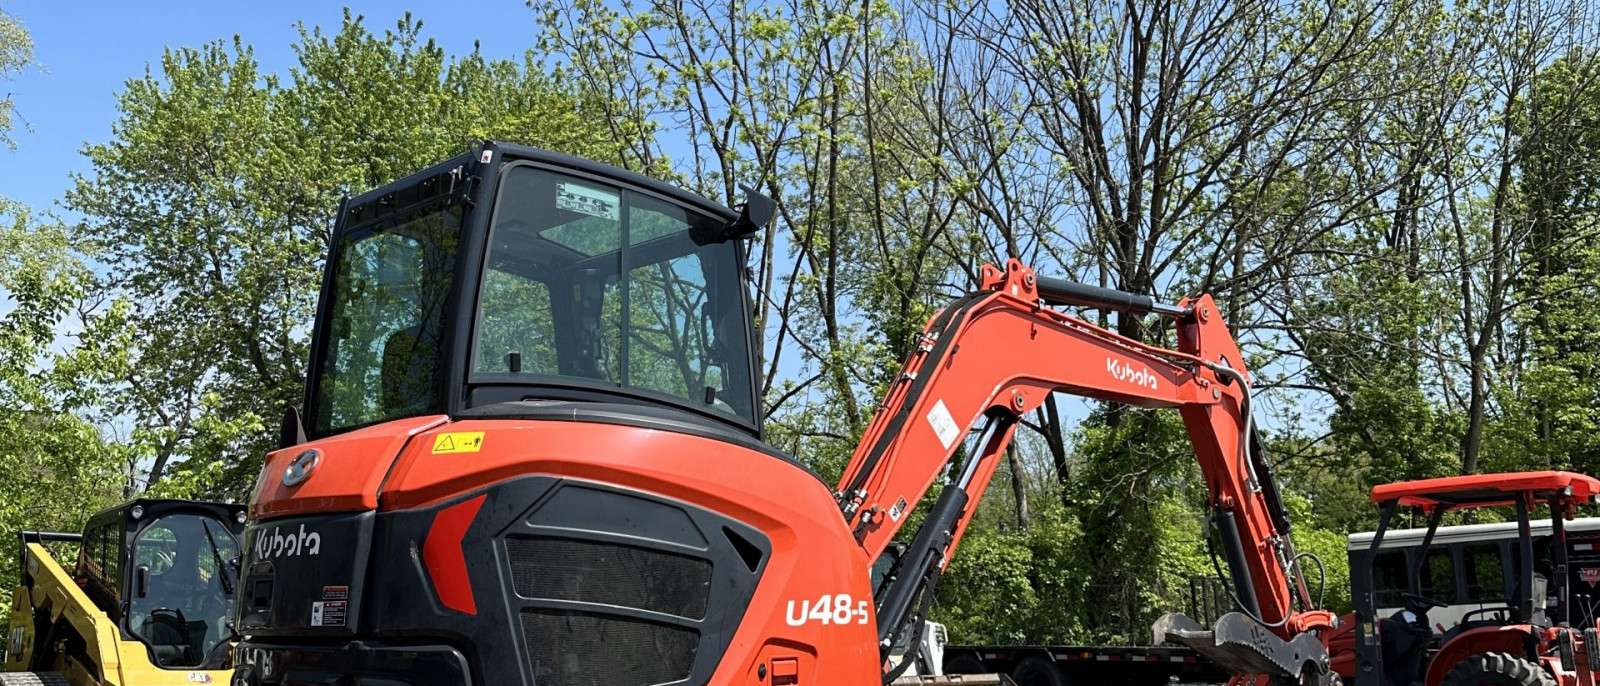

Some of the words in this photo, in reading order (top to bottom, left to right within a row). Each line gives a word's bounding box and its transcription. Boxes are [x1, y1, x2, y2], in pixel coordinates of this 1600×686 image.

[1106, 356, 1158, 390] Kubota
[254, 523, 321, 560] Kubota
[786, 593, 868, 626] U48-5
